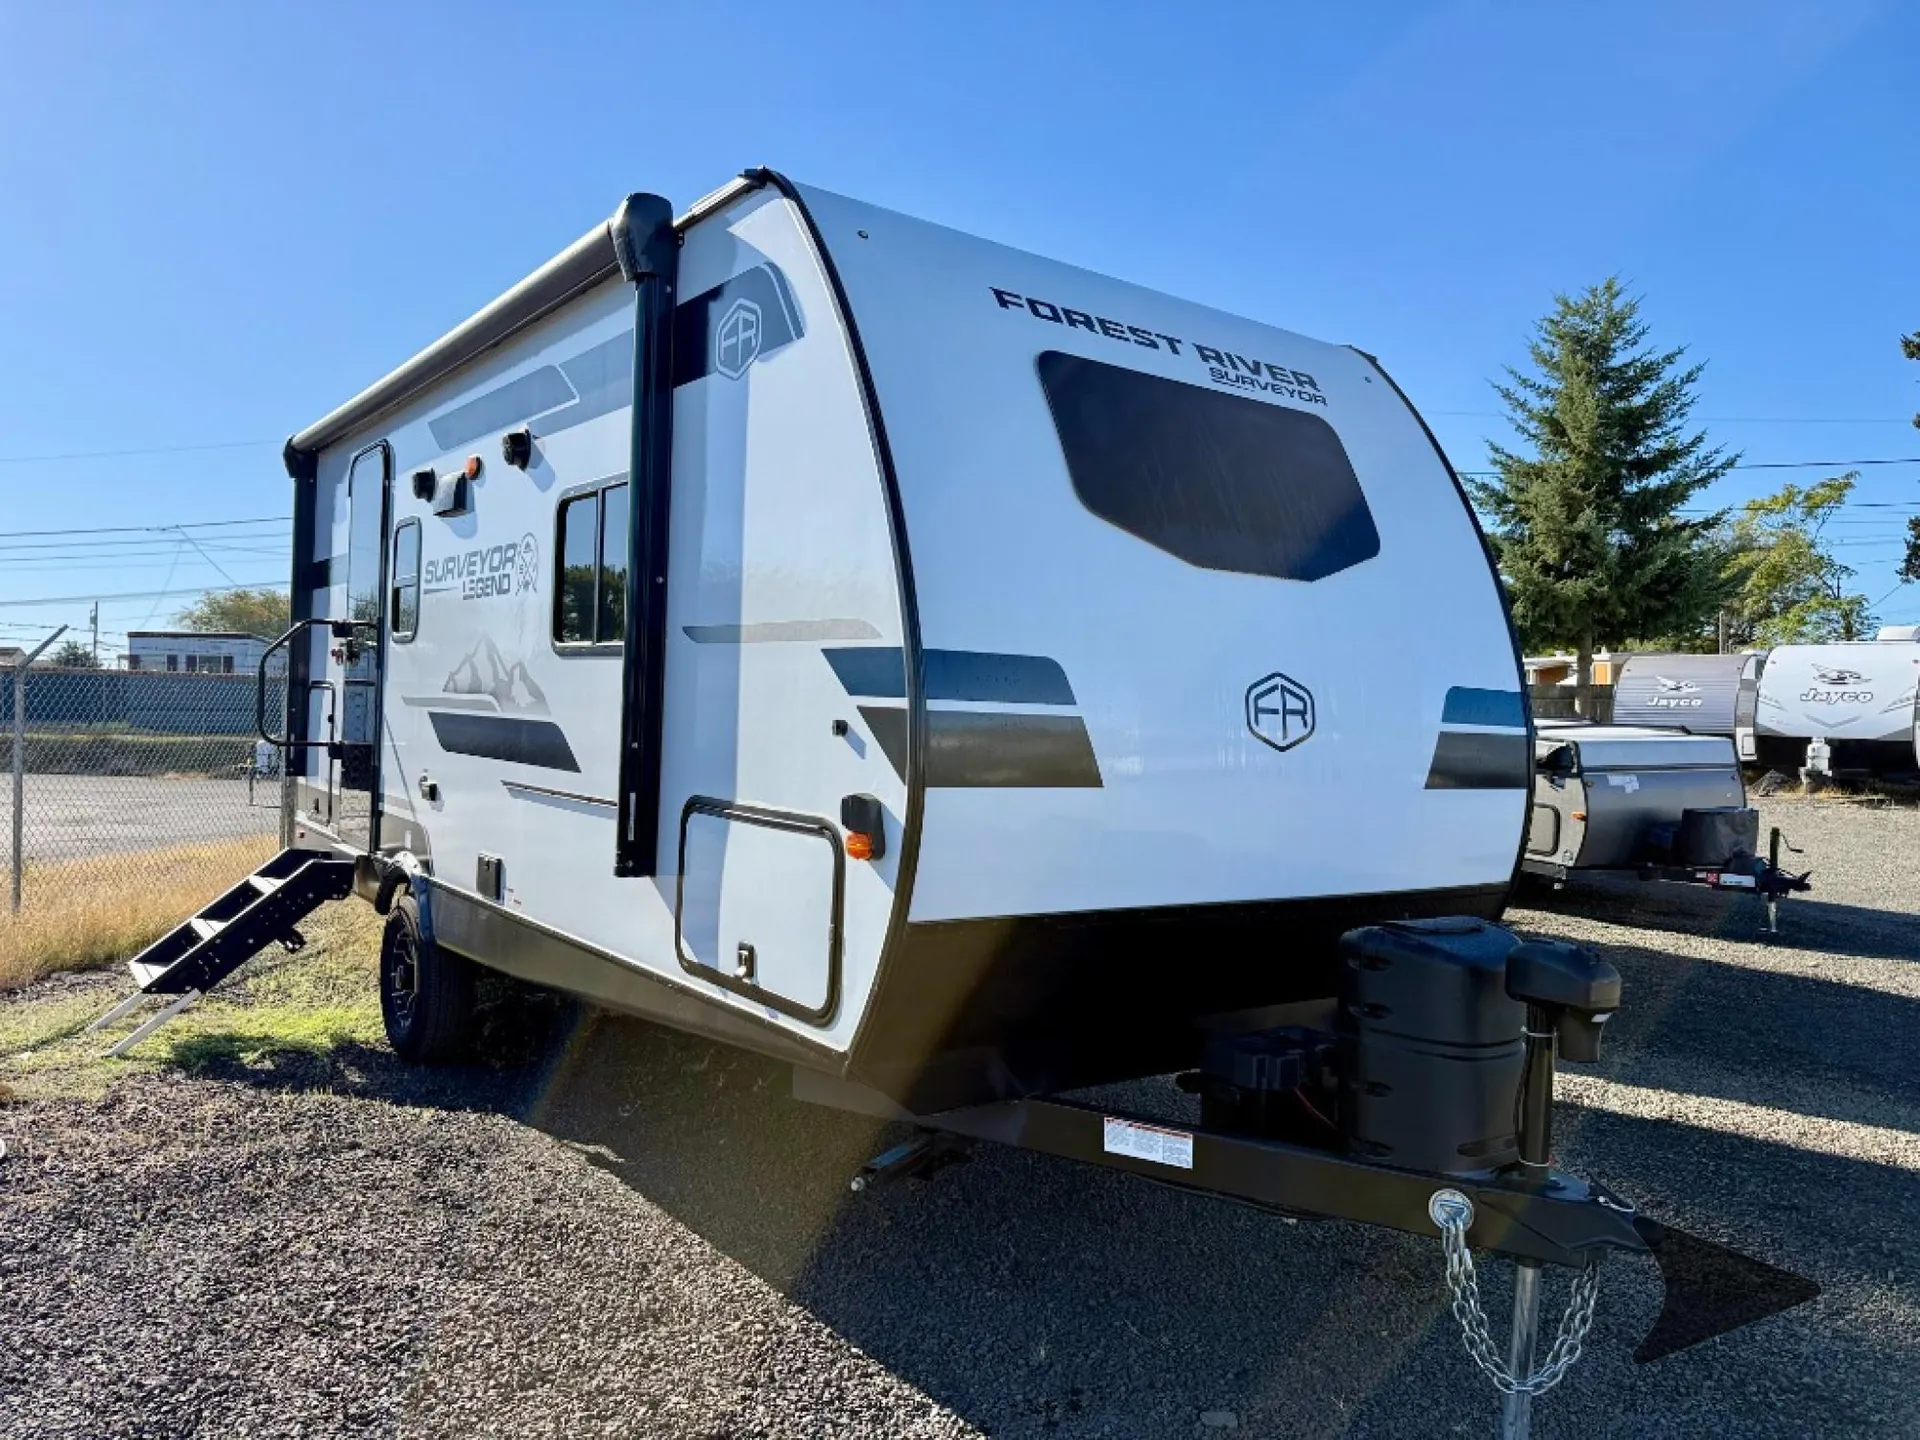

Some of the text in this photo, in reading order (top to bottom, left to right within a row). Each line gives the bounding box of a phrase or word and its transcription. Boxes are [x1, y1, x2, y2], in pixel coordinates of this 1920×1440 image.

[989, 286, 1320, 392] FOREST RIVER
[1209, 366, 1328, 407] SURVEYOR
[424, 542, 518, 583] SURVEYOR
[462, 573, 511, 600] LEGEND
[1646, 696, 1703, 709] Jayco
[1800, 688, 1873, 705] Jayco
